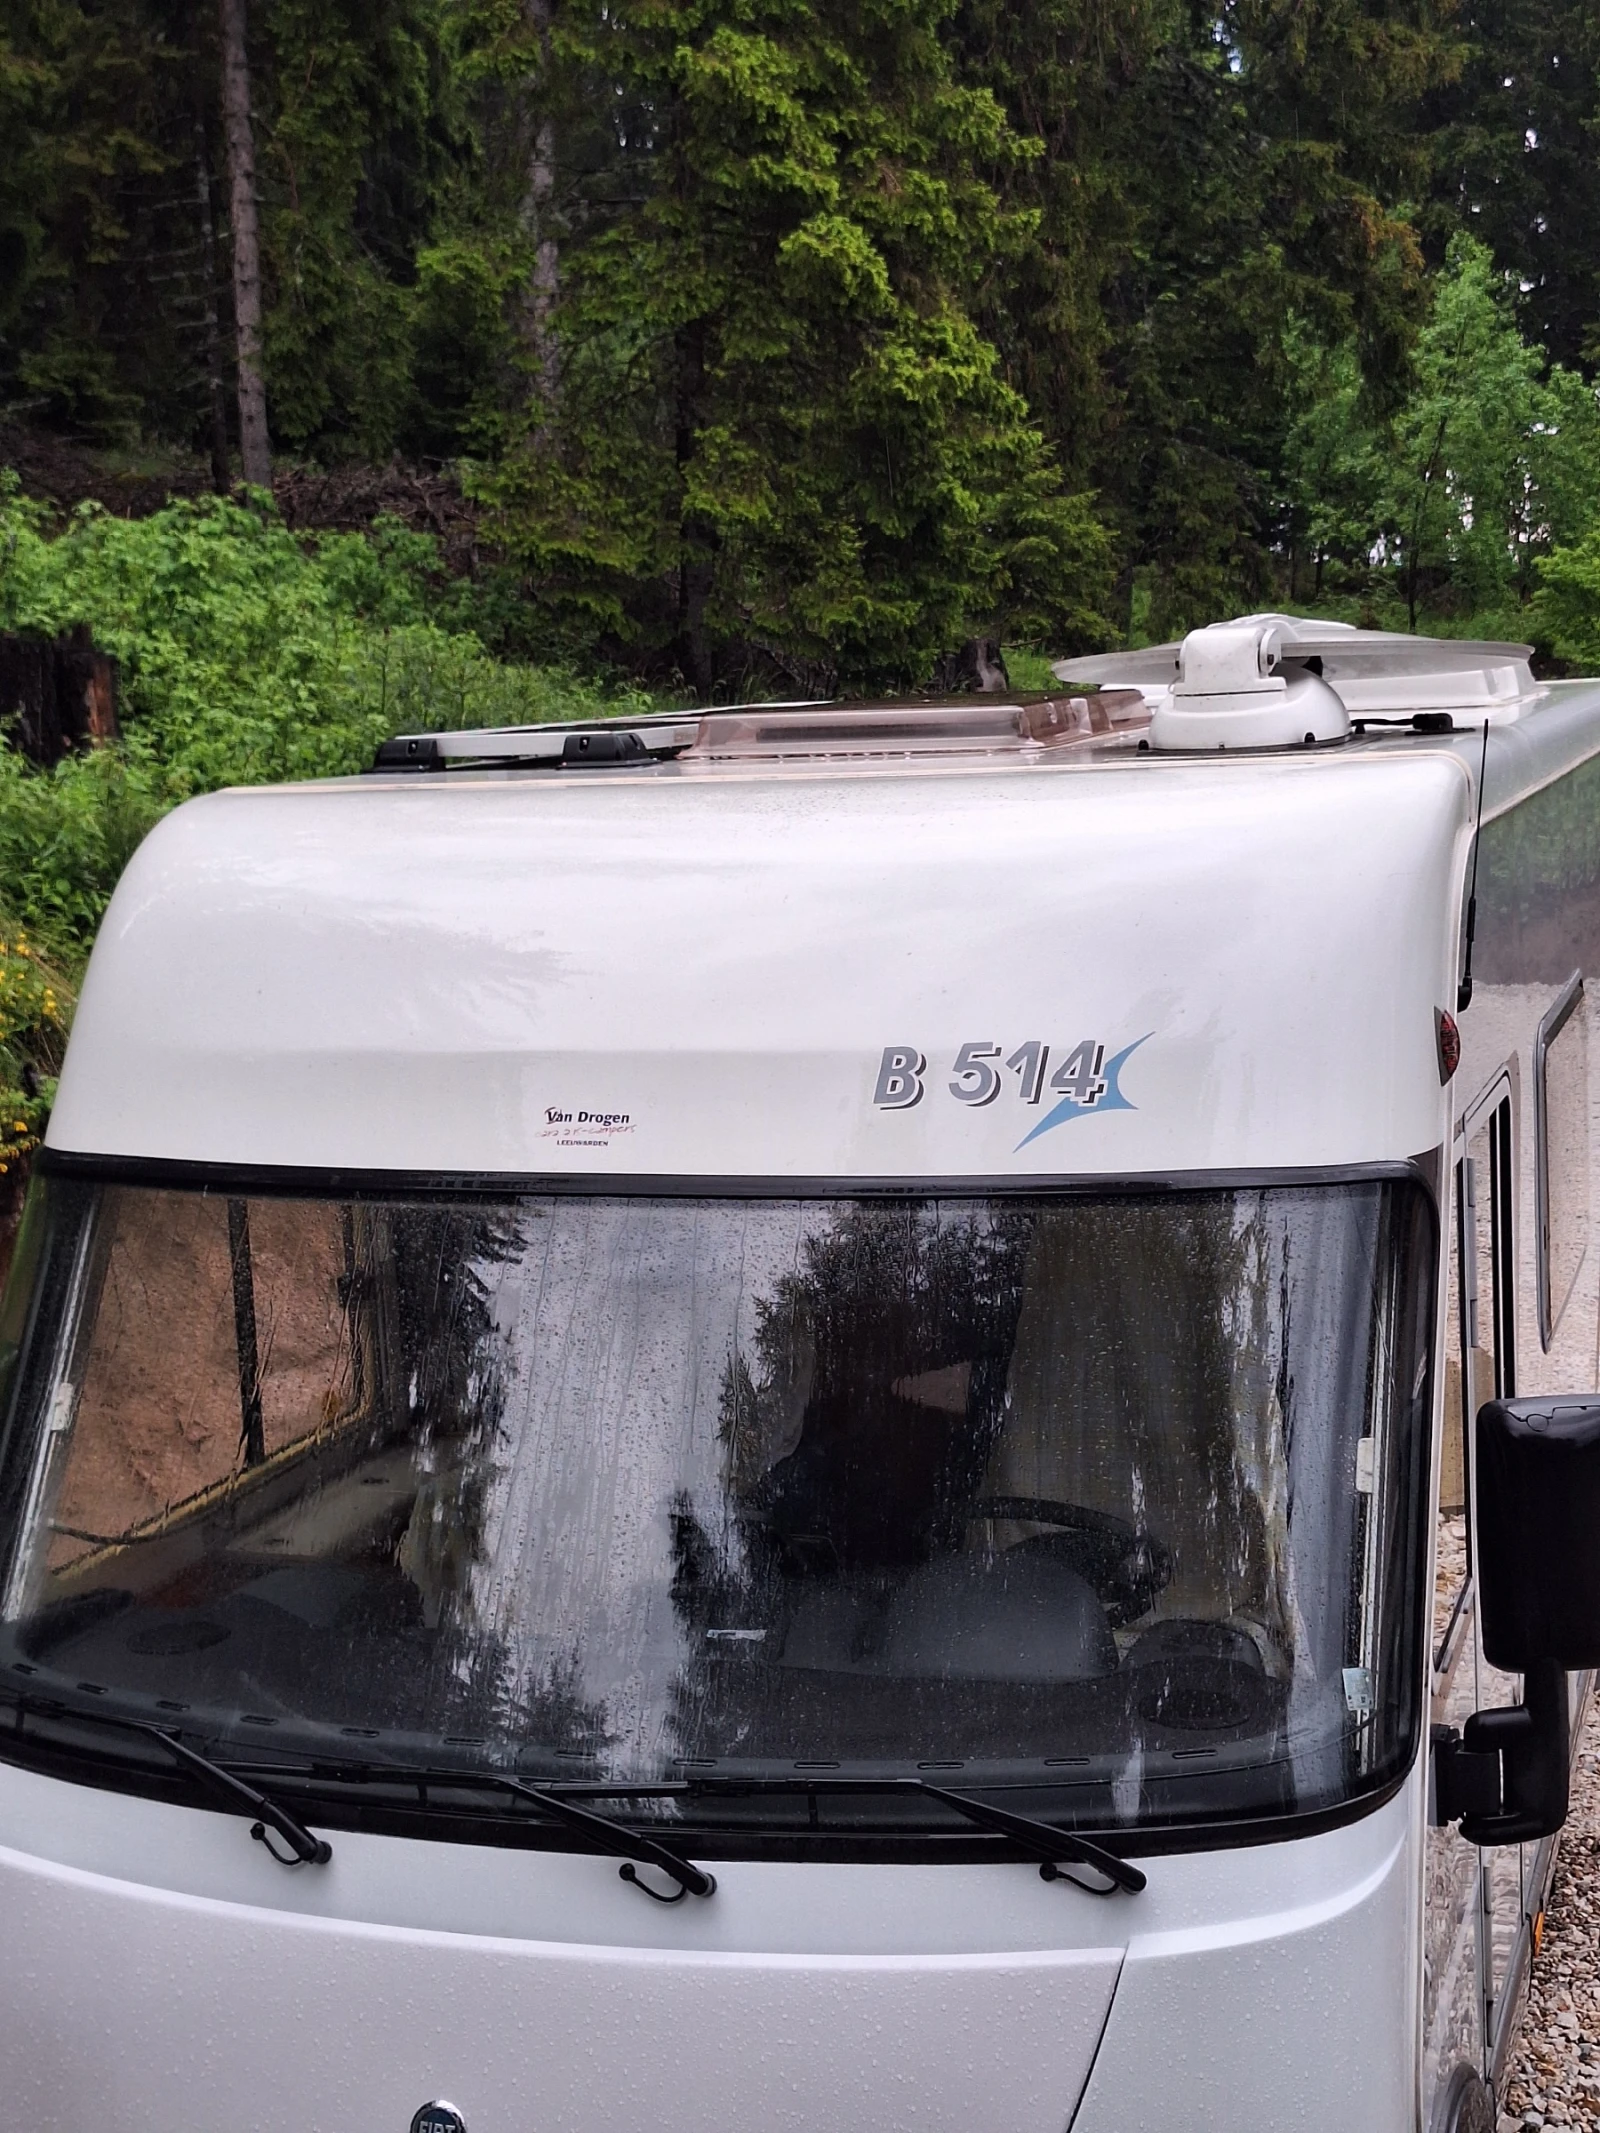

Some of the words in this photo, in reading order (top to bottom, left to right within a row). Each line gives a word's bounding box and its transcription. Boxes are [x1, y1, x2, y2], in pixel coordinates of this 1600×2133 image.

[873, 1045, 928, 1111] B
[948, 1039, 1106, 1108] 514
[547, 1110, 573, 1123] Van
[577, 1111, 630, 1126] Drogen
